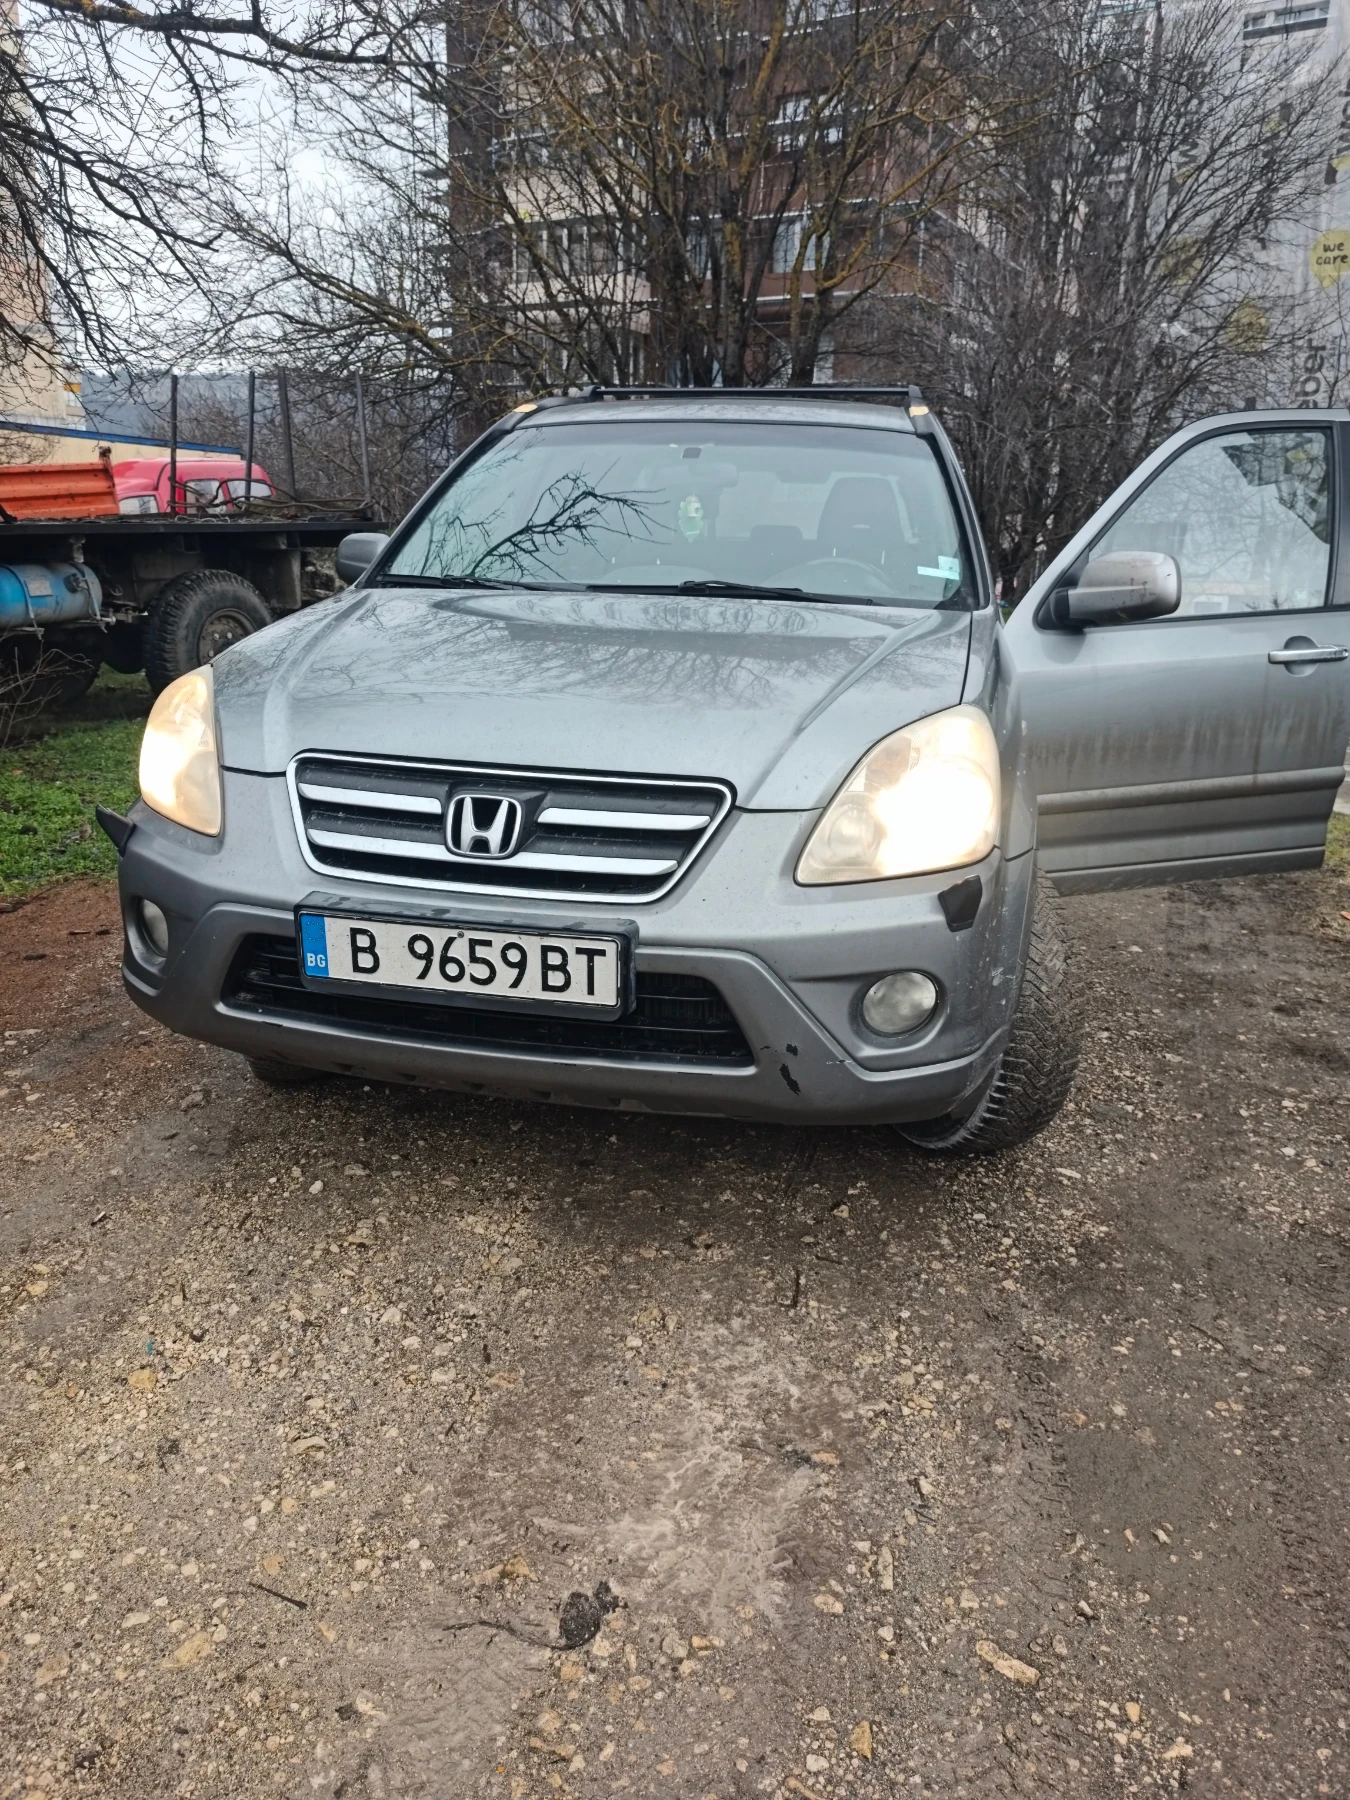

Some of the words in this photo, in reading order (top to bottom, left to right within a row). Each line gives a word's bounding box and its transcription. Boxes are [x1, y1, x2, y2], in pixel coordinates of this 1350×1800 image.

[1323, 242, 1345, 253] we
[1315, 254, 1349, 266] care
[306, 952, 326, 969] BG
